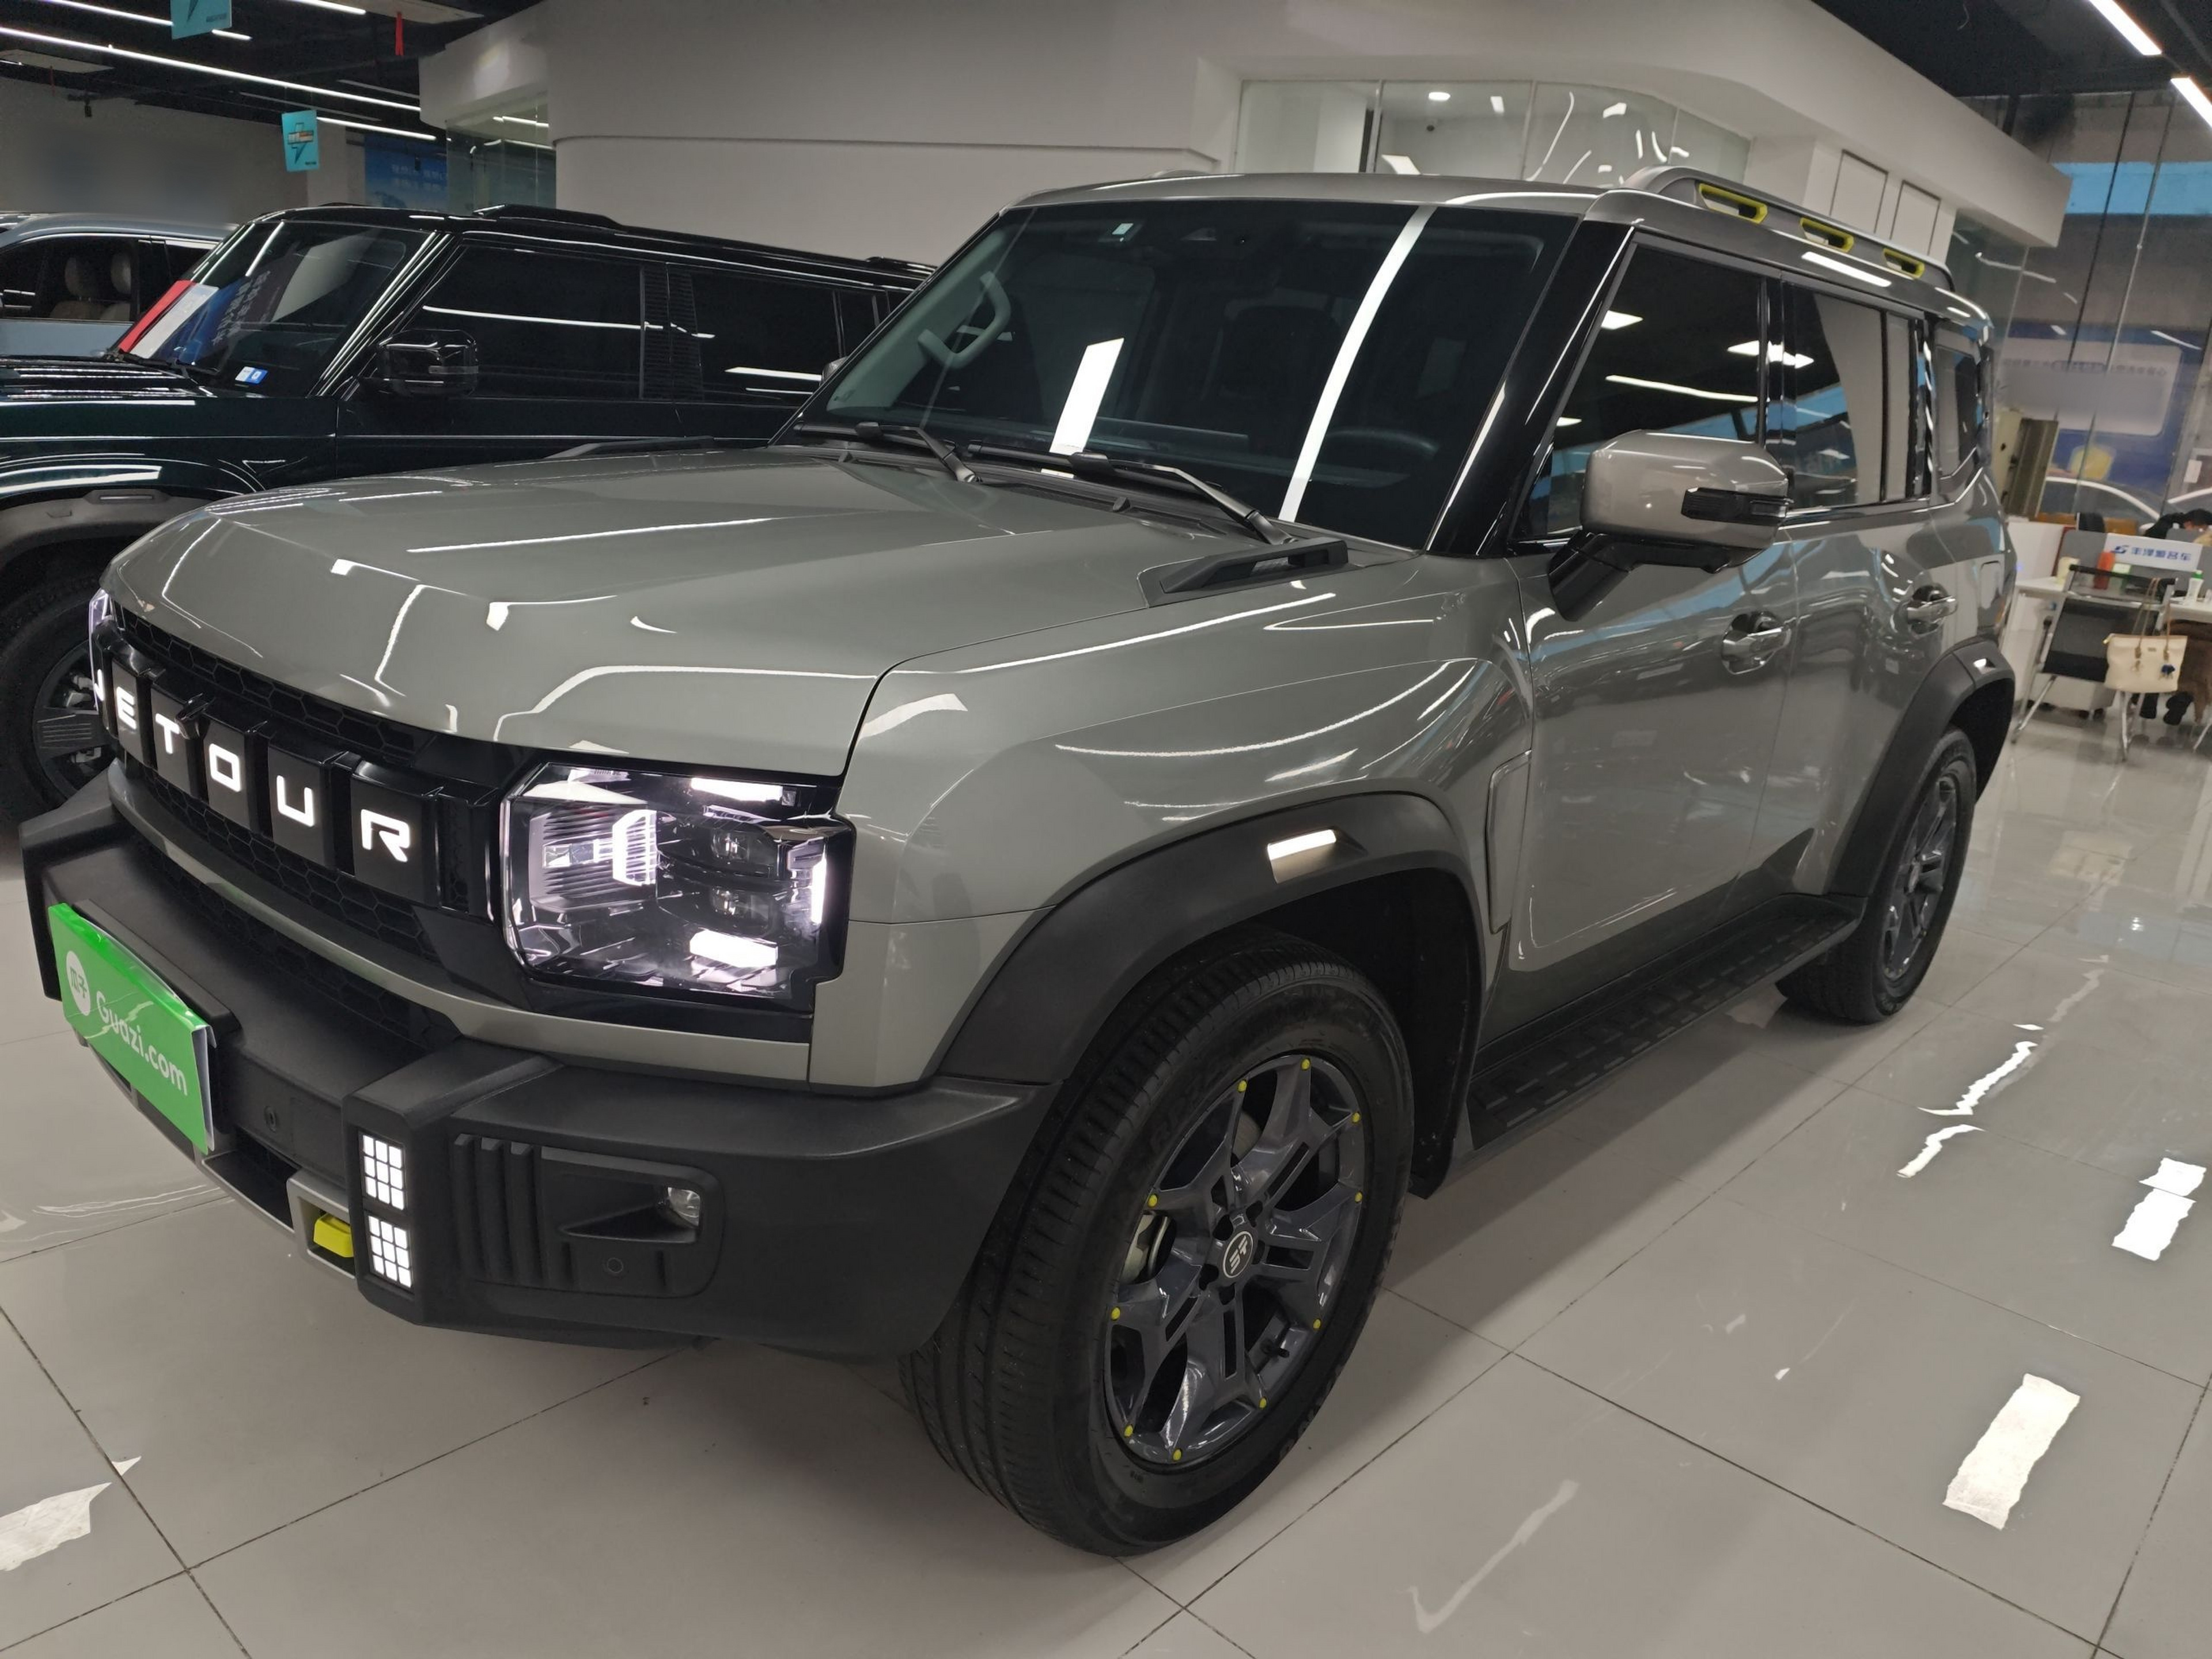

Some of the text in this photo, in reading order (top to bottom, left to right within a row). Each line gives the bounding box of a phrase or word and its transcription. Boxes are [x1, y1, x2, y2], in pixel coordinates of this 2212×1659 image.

[94, 669, 410, 863] JETOUR
[69, 966, 89, 998] 瓜子
[96, 990, 188, 1096] Guazi.com
